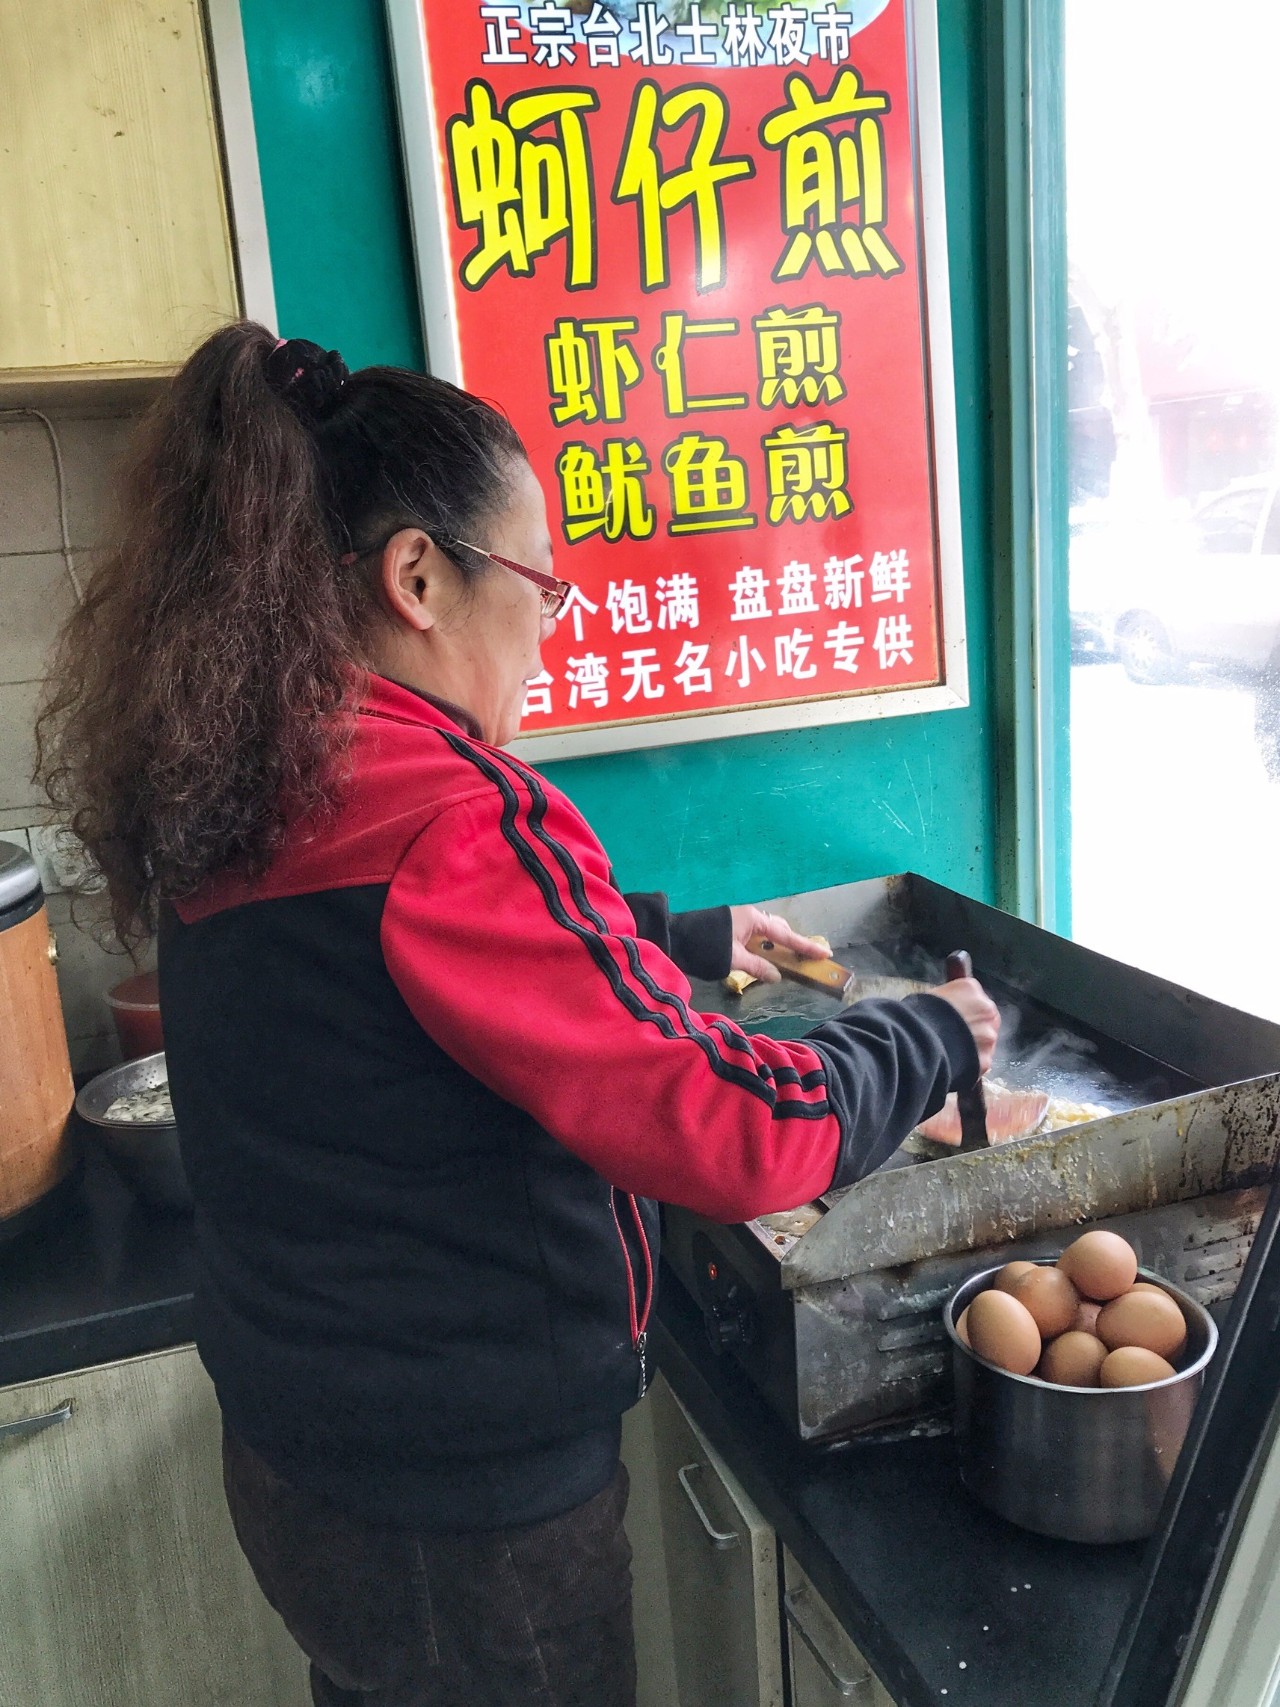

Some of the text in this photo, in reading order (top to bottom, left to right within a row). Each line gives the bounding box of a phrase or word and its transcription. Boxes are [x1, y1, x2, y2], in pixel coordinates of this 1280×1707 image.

[480, 2, 854, 68] 正宗台北士林夜市
[447, 67, 904, 293] 蚵仔煎
[545, 303, 847, 427] 虾仁煎
[555, 421, 854, 545] 鱿鱼煎
[728, 549, 912, 622] 盘盘新鲜
[521, 615, 915, 717] 台湾无名小吃专供
